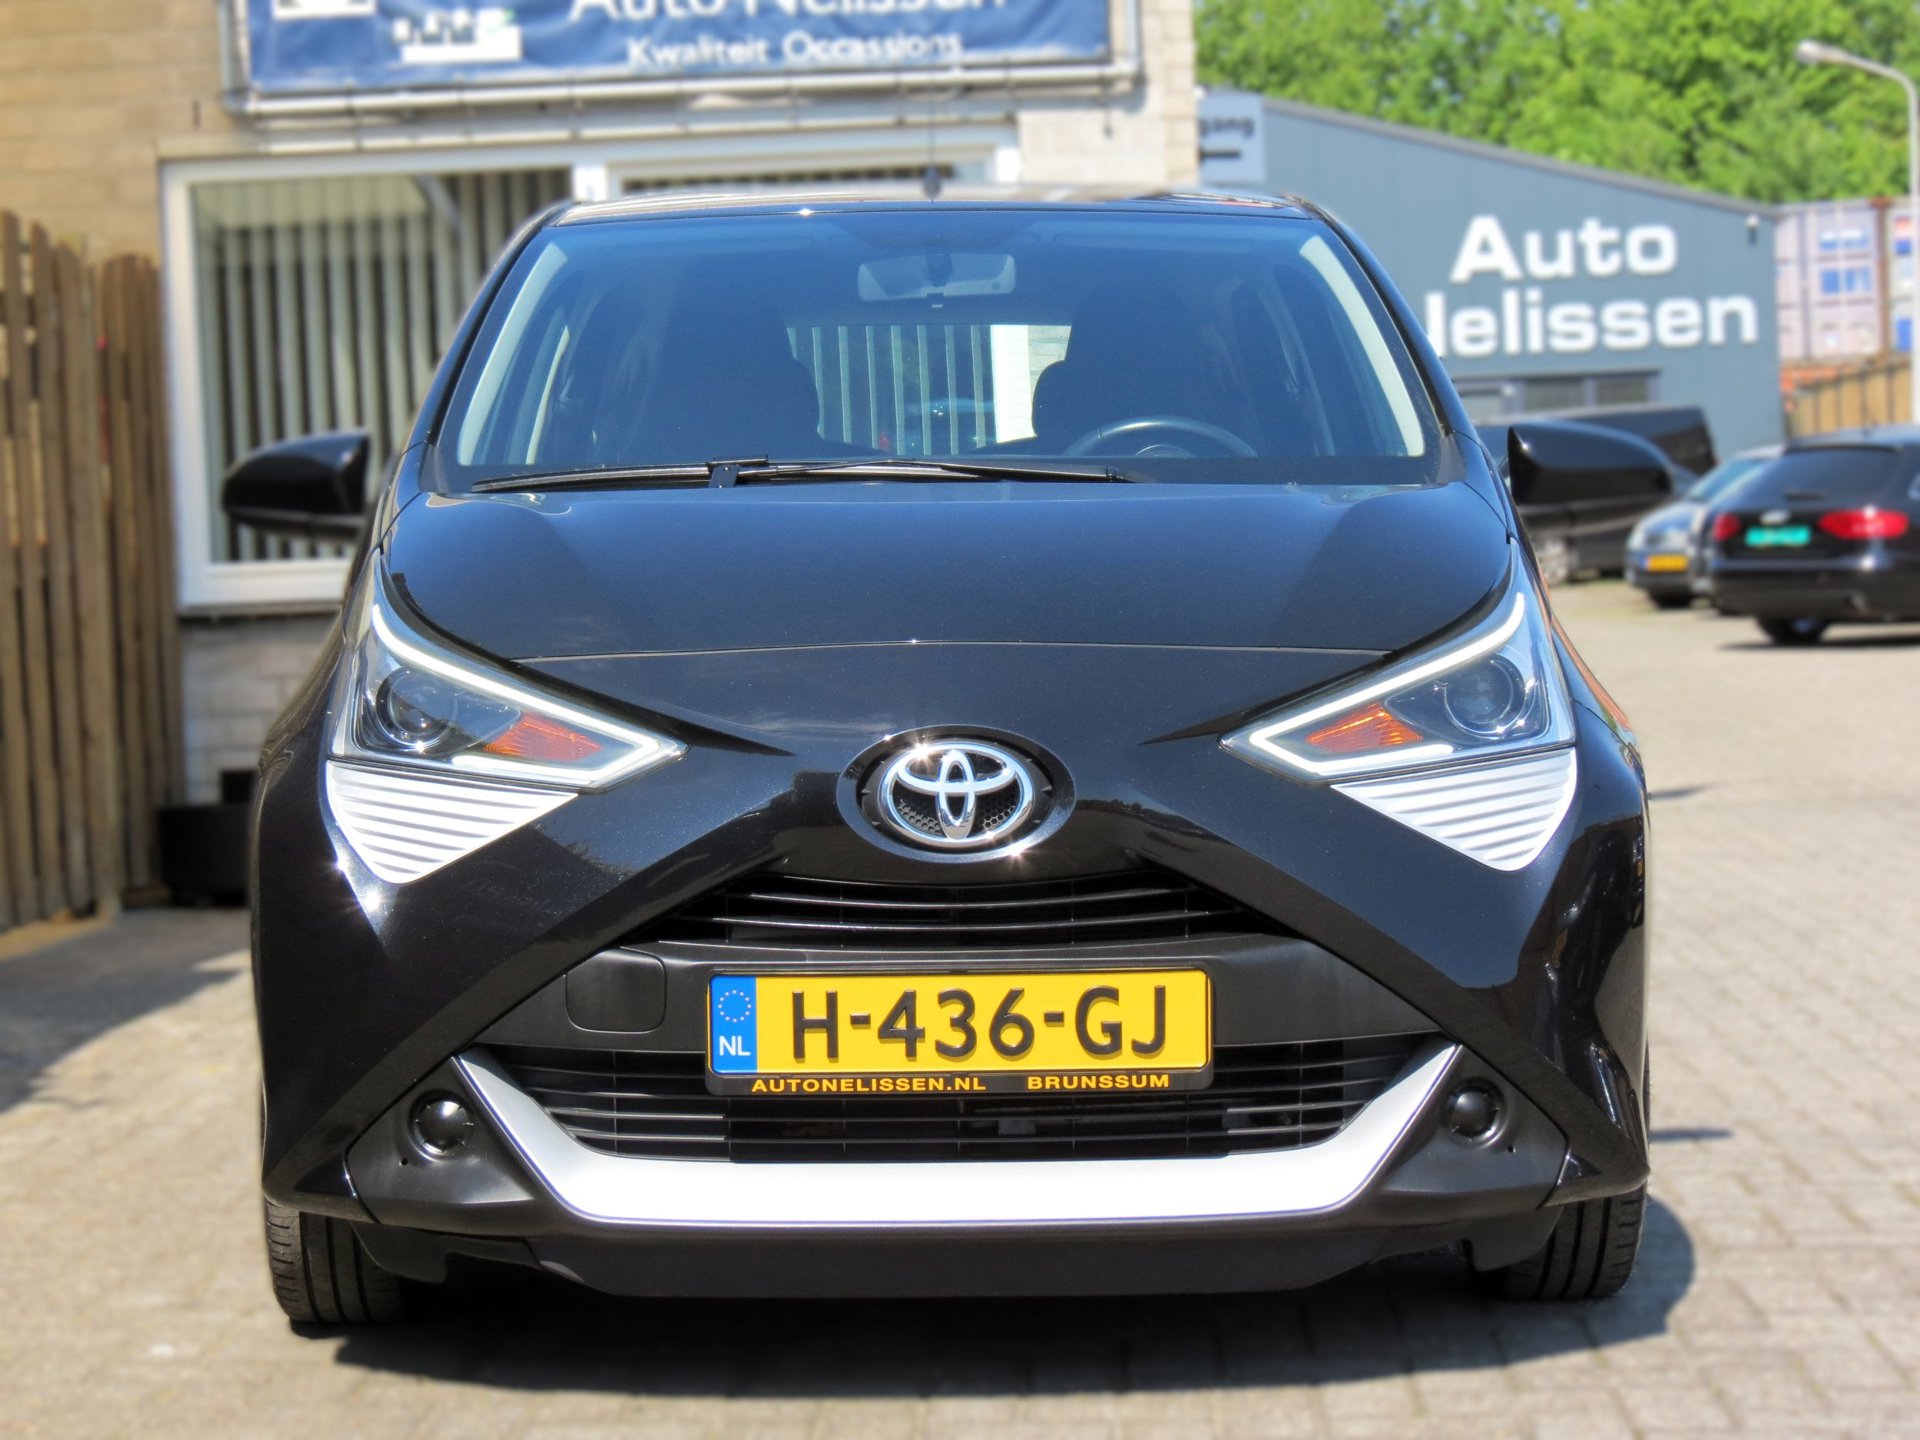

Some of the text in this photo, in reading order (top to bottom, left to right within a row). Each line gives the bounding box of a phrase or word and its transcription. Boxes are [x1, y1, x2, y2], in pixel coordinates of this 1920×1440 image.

[626, 37, 769, 67] Kwaliteit
[1450, 214, 1678, 283] Auto
[792, 984, 1168, 1063] H-436-GJ
[718, 1035, 751, 1057] NL
[751, 1073, 1170, 1093] AUTONELISSEN.NL BRUNSSUM
